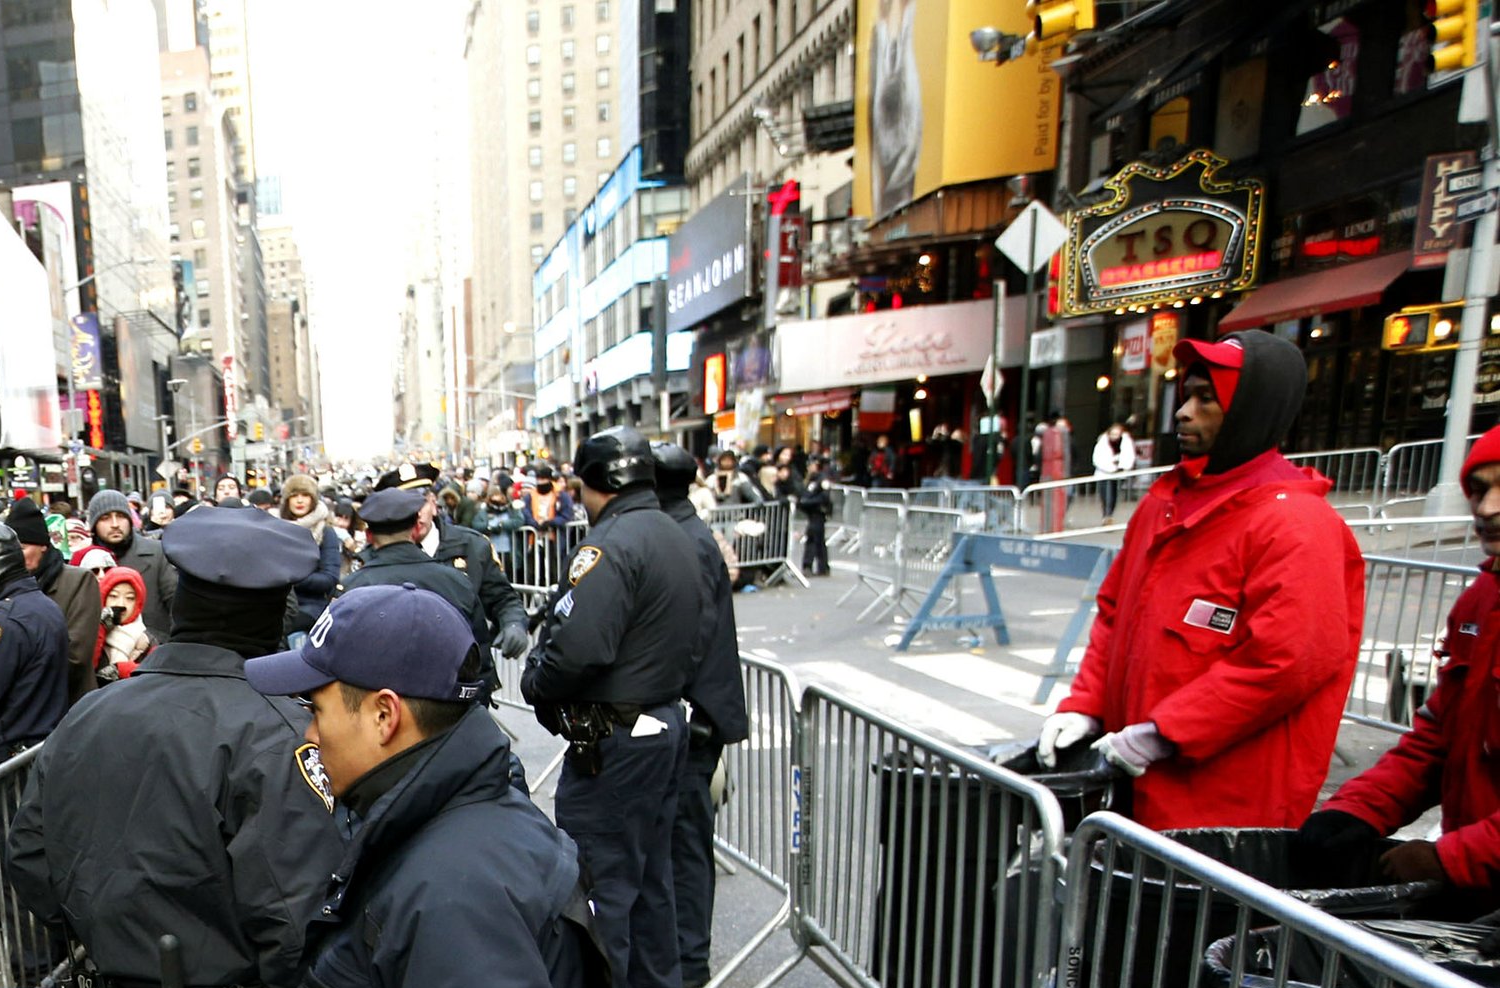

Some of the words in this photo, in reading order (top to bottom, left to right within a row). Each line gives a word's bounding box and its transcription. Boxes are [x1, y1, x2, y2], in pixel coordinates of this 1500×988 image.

[1038, 78, 1054, 95] by
[1037, 101, 1051, 118] for
[1035, 123, 1050, 155] Paid
[1345, 219, 1374, 238] LUNCH
